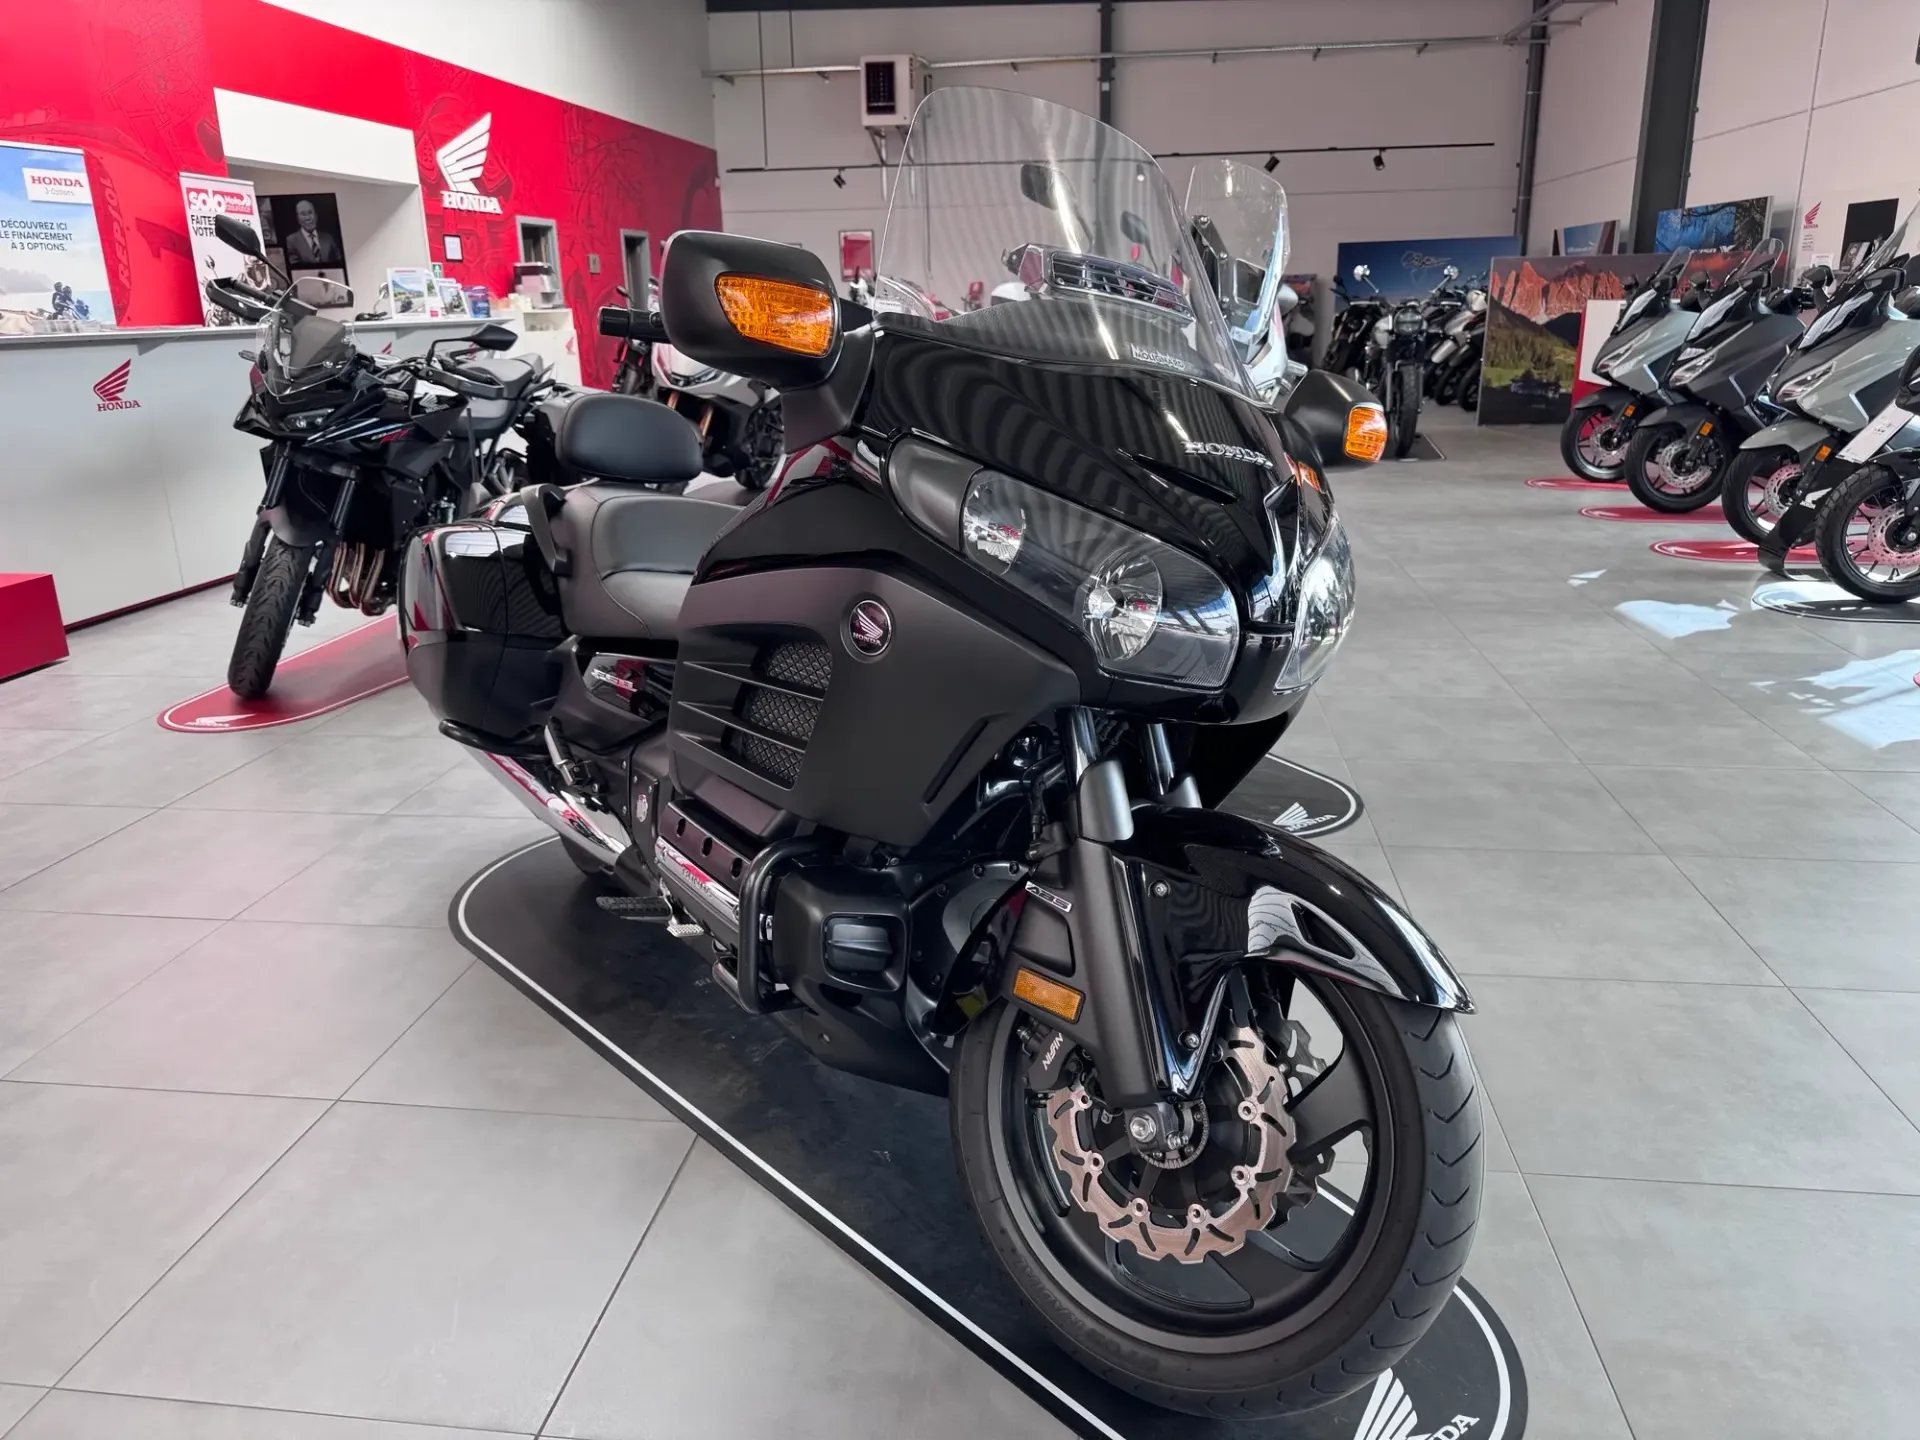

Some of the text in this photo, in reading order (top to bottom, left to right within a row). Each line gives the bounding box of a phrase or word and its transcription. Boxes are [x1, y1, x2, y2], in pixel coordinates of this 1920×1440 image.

[30, 175, 84, 188] HONDA
[440, 190, 503, 214] HONDA
[0, 218, 68, 231] DÉCOUVREZ ICI
[12, 230, 73, 241] FINANCEMENT
[191, 226, 217, 237] VOTR
[19, 242, 25, 250] 3
[27, 241, 68, 252] OPTIONS.
[96, 400, 142, 412] HONDA
[1181, 441, 1273, 468] HONDA
[852, 631, 882, 646] HONDA
[1284, 814, 1338, 832] HONDA
[1026, 884, 1070, 910] ABS
